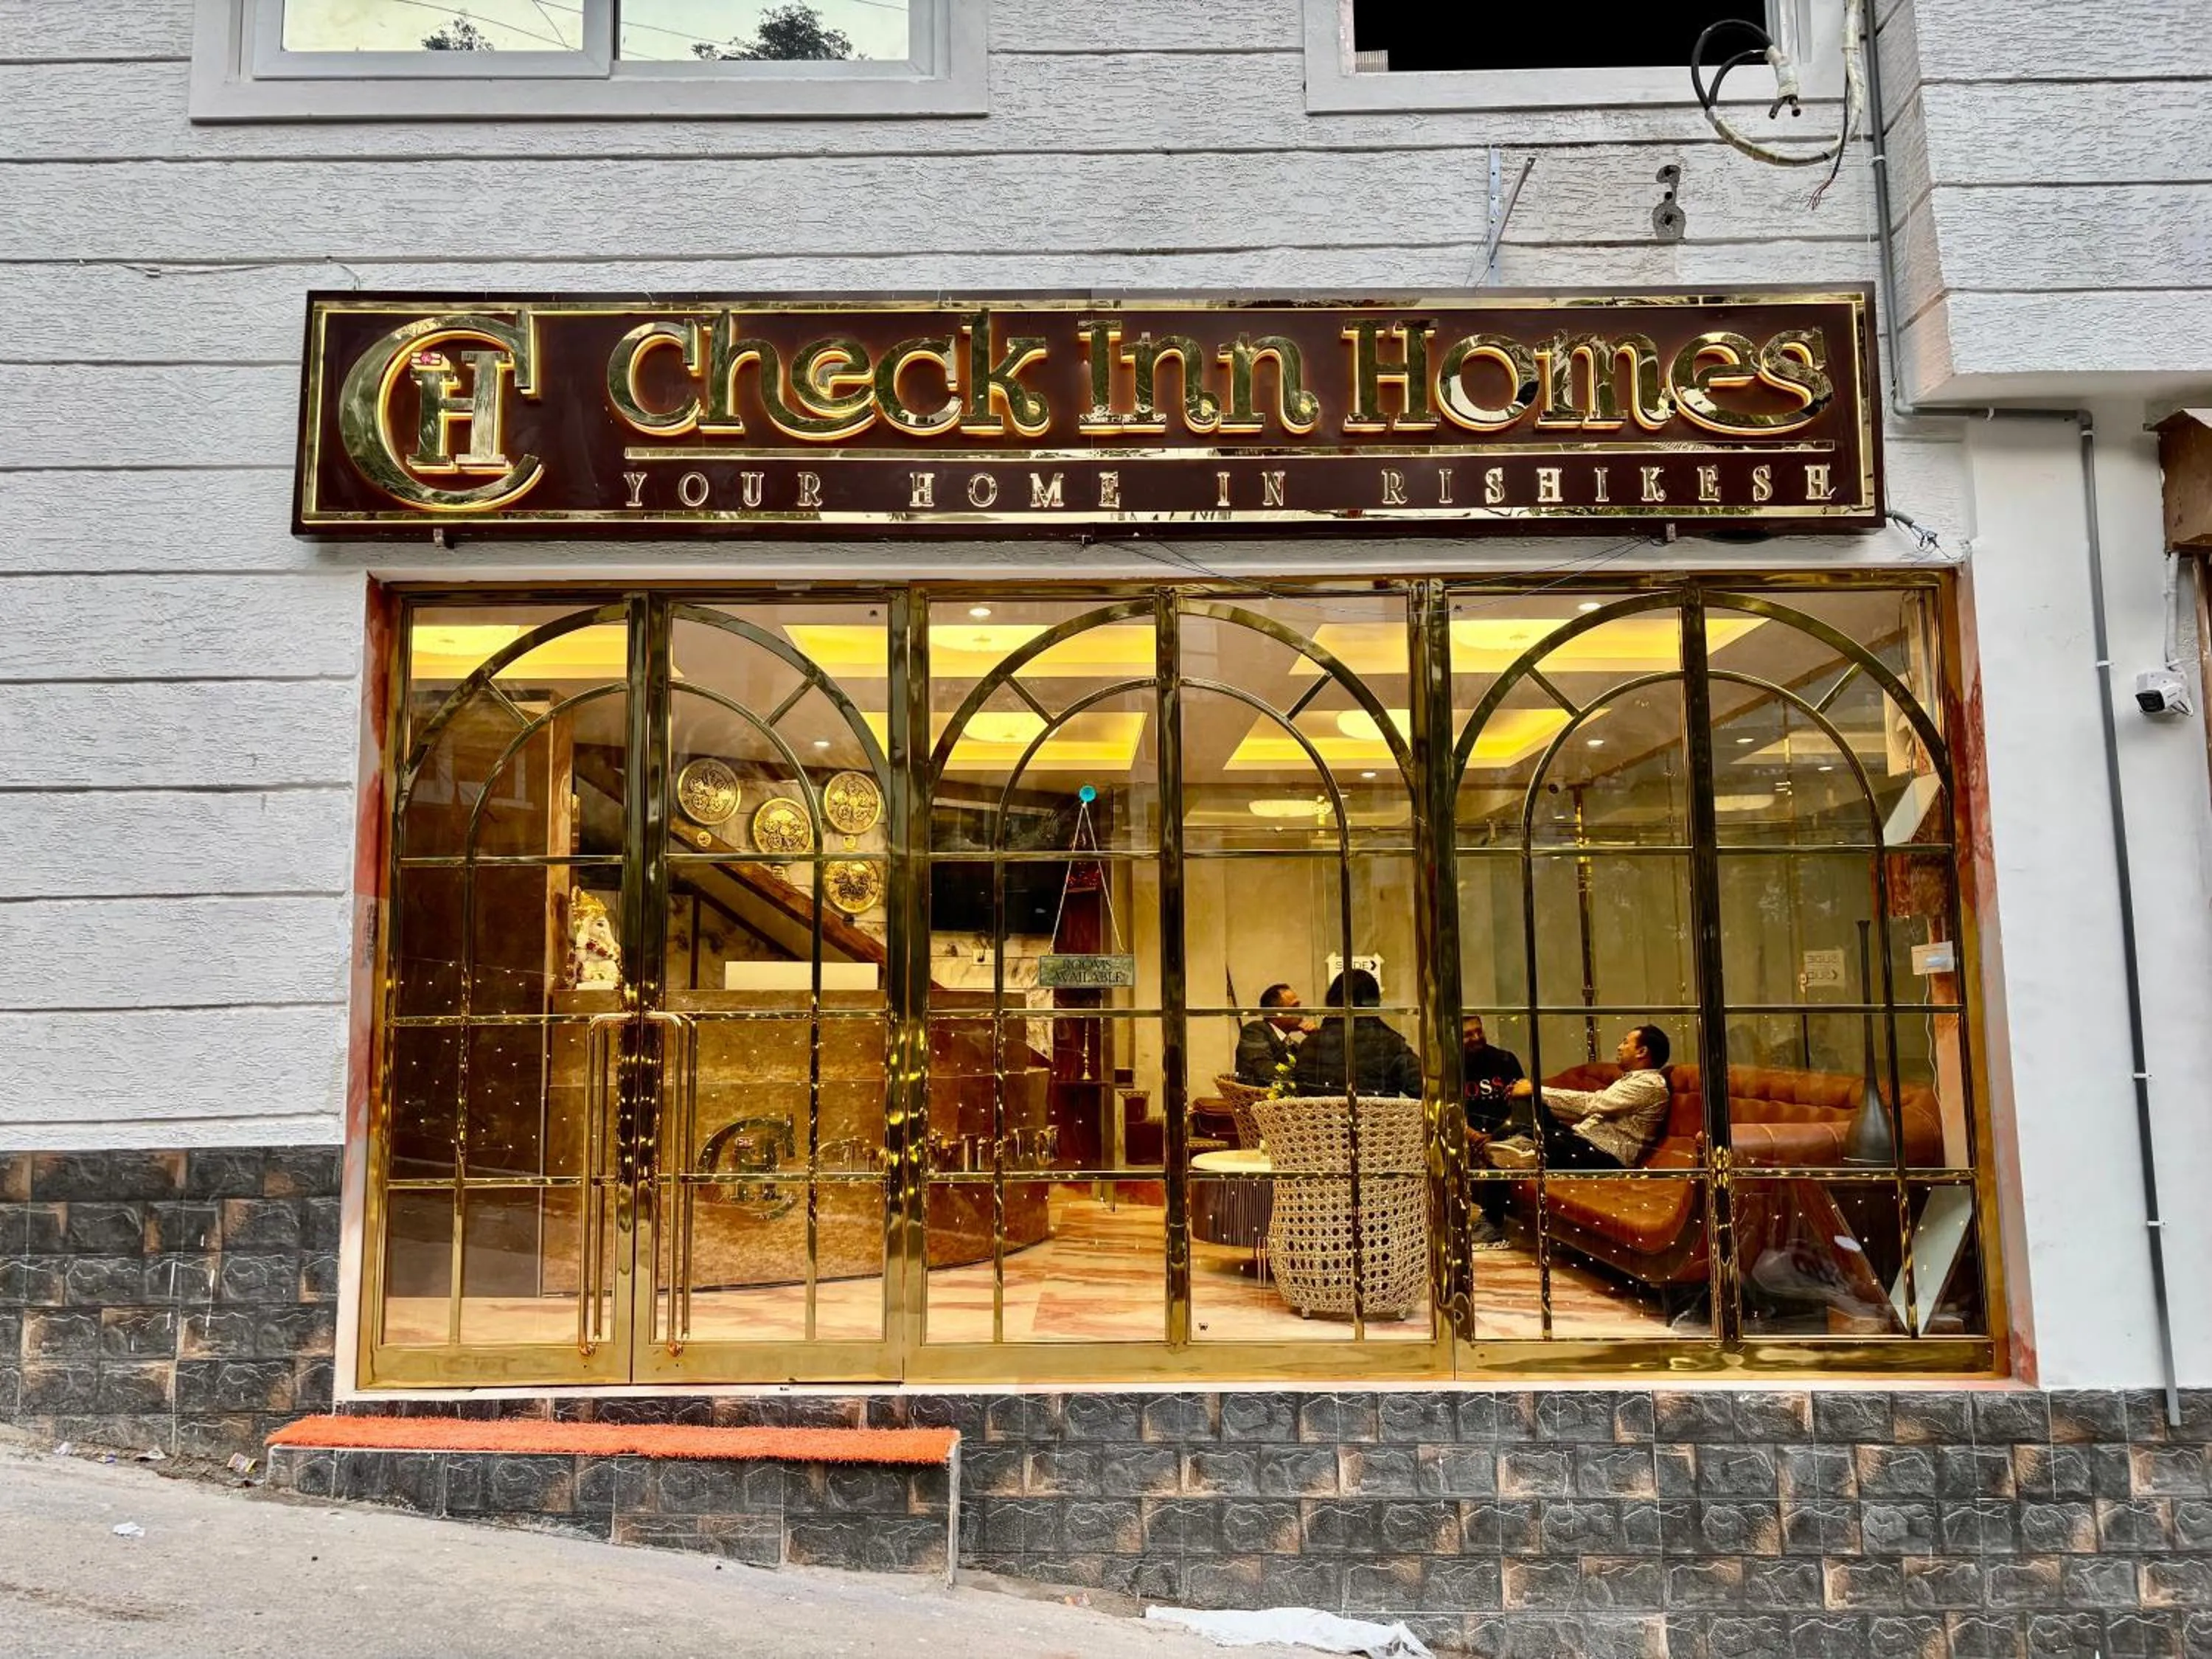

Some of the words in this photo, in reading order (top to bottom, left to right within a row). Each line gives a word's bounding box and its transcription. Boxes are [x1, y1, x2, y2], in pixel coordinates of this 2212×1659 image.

[608, 307, 1051, 440] Check
[1077, 319, 1321, 434] Inn
[1341, 318, 1834, 435] Homes
[625, 472, 822, 507] YOUR
[909, 471, 1121, 509] HOME
[1217, 470, 1286, 507] IN
[1382, 464, 1837, 505] RISHIKESH
[1062, 959, 1110, 970] ROOMS
[1335, 961, 1369, 970] SDE
[1054, 971, 1124, 982] AVAILABLE
